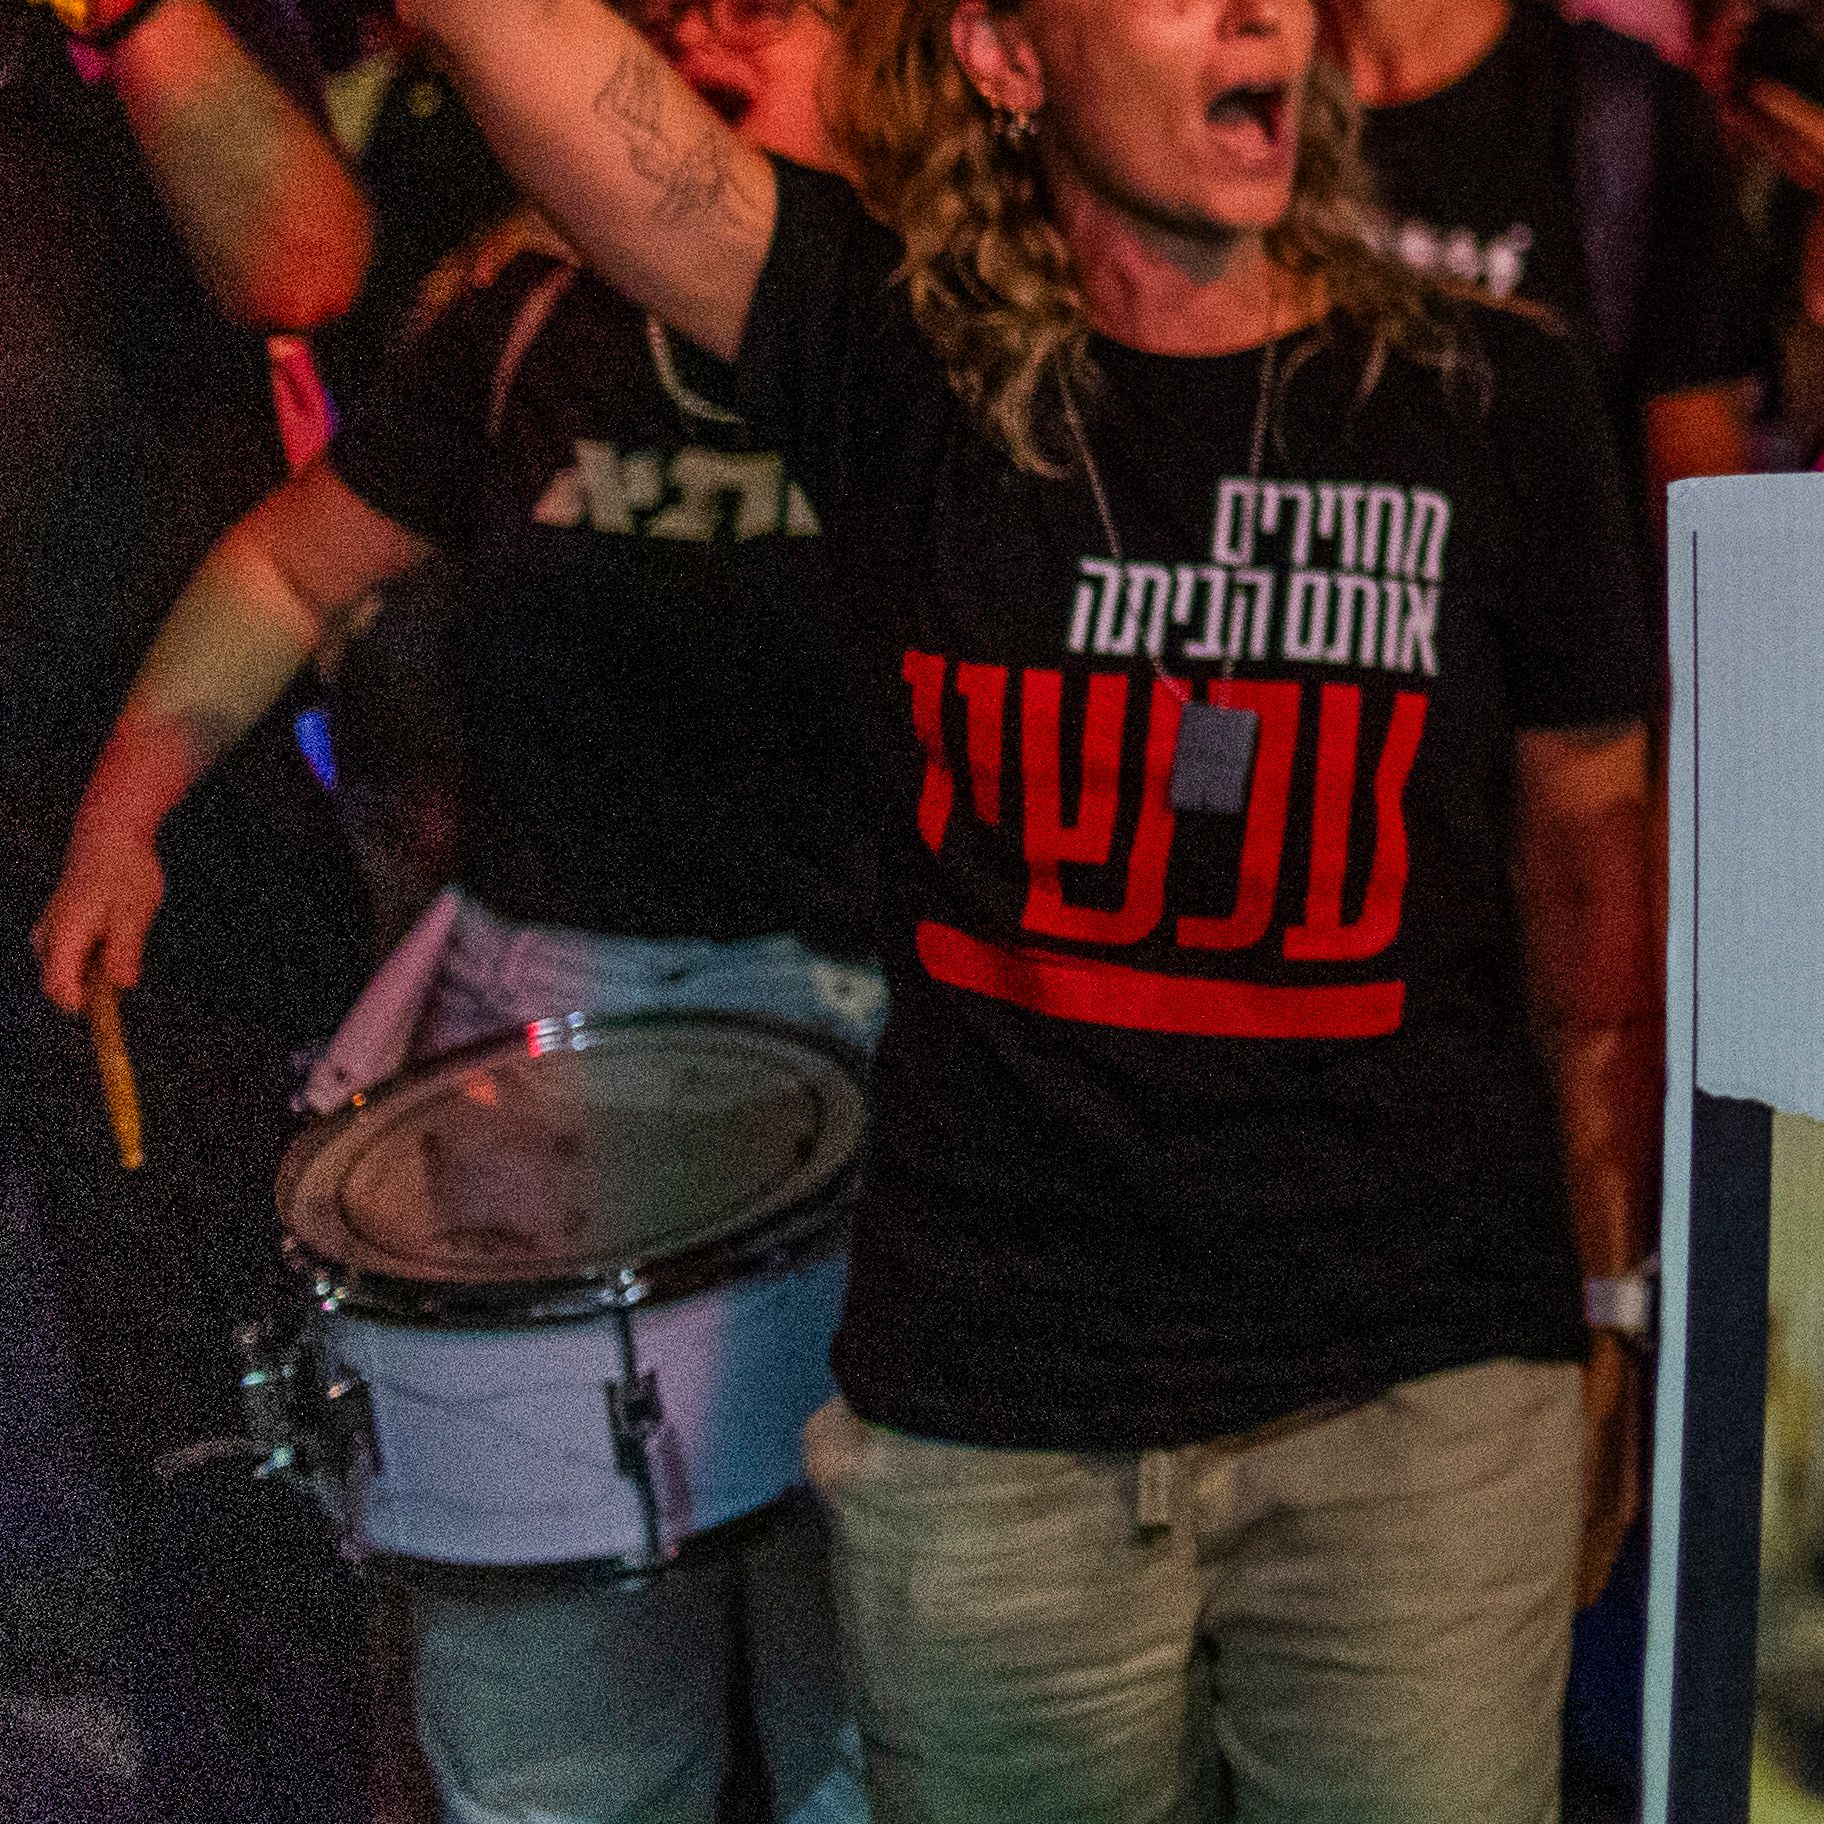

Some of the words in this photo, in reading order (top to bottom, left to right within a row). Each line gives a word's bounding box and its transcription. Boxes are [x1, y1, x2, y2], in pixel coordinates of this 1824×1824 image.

[1211, 476, 1452, 582] מחזירים
[1065, 553, 1275, 662] הביתה
[1281, 567, 1441, 677] אותם
[902, 647, 1430, 962] עכשיו
